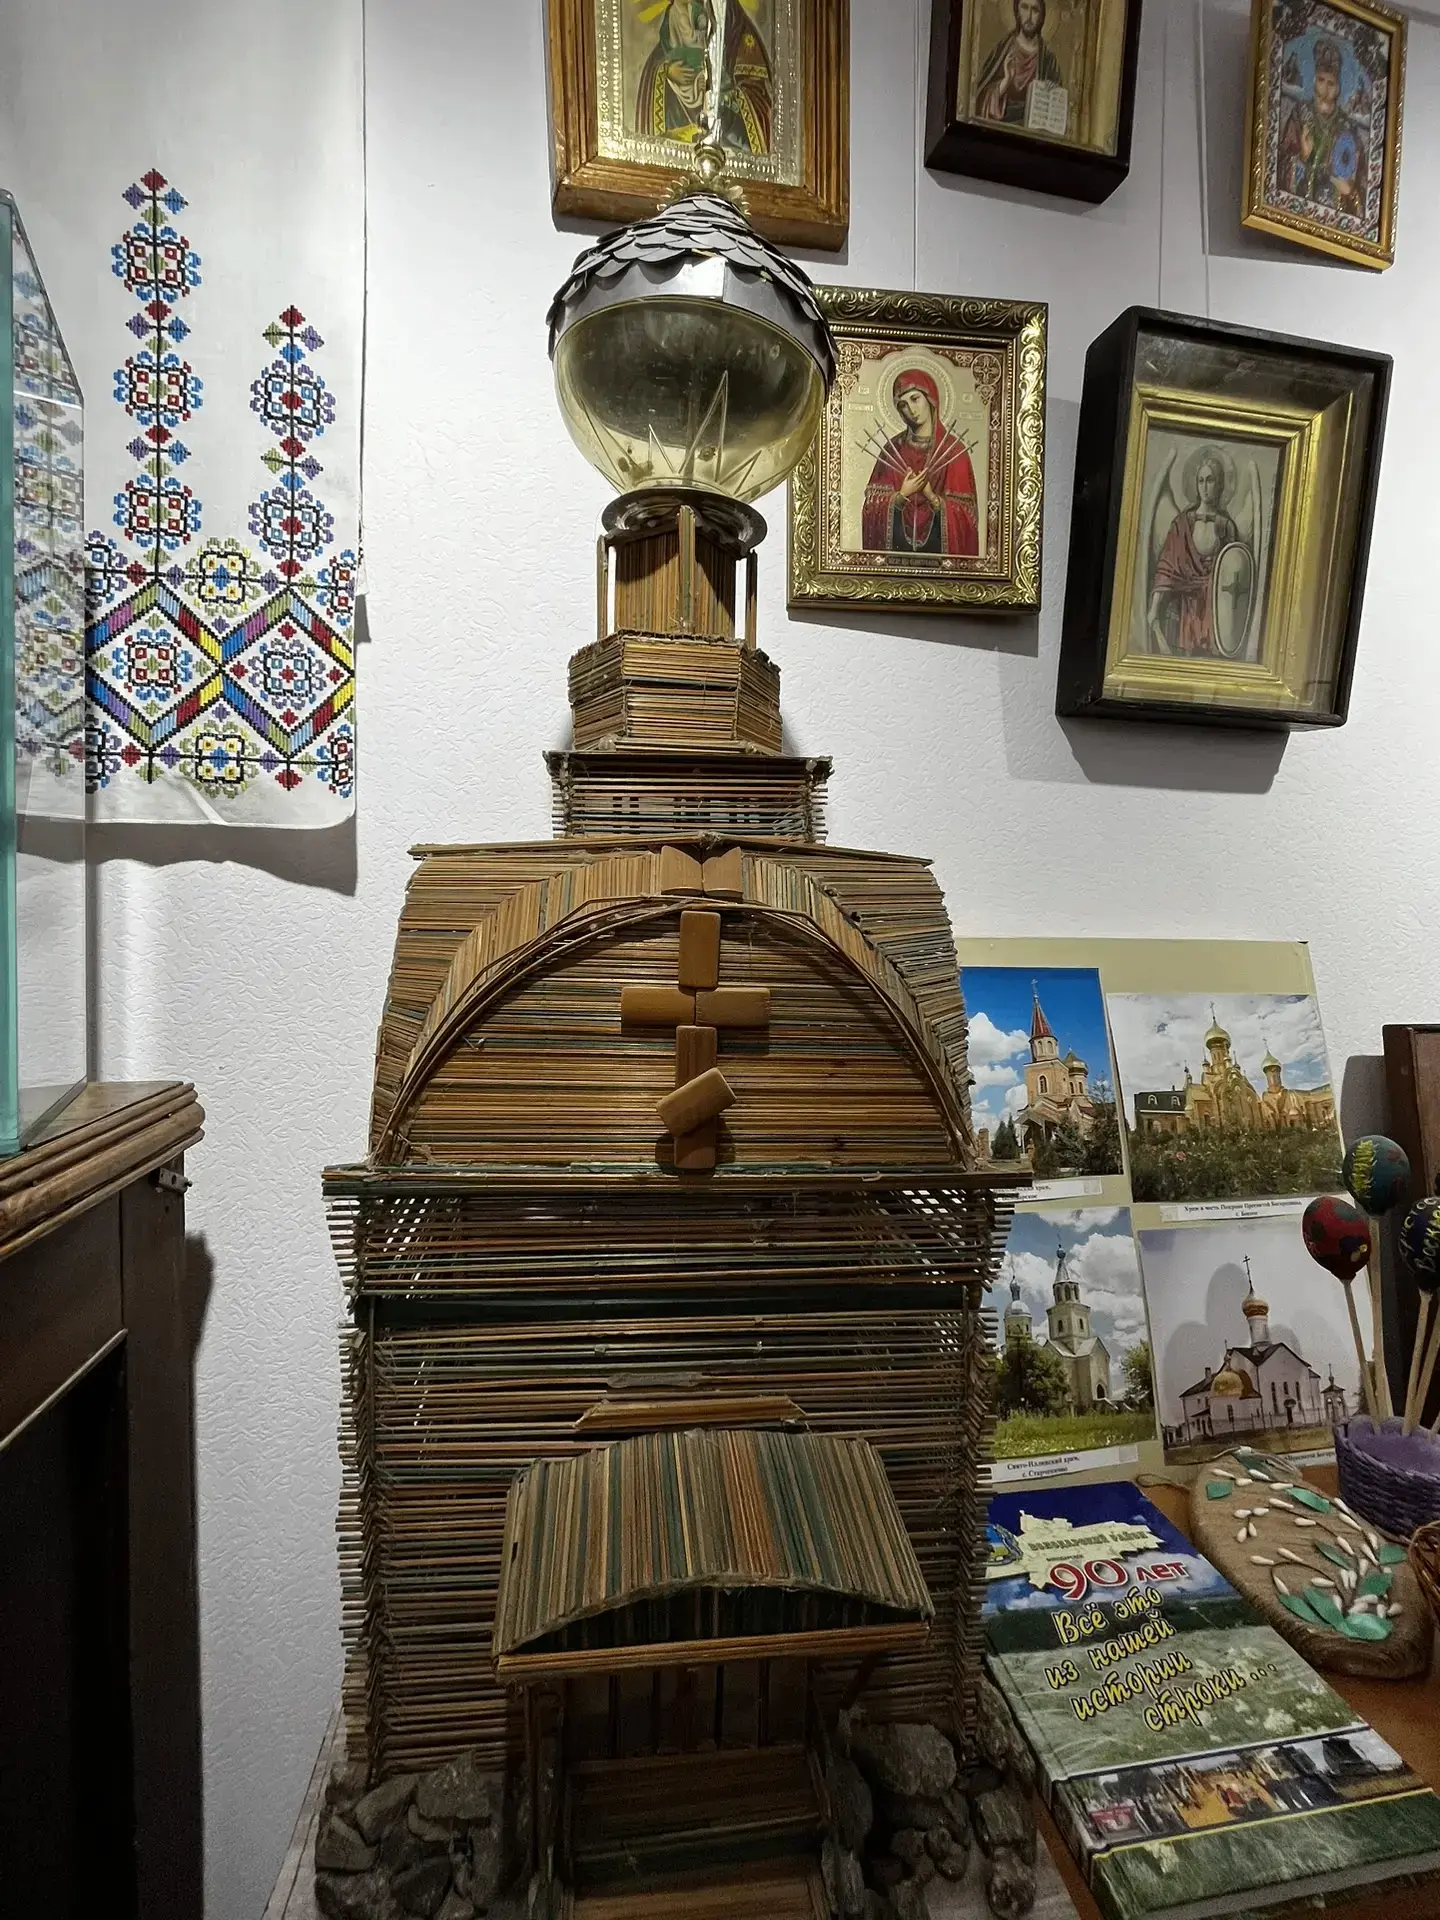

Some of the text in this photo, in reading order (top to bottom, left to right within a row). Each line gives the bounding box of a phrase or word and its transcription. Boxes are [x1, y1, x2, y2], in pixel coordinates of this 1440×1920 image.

[1050, 1559, 1128, 1600] 90
[1052, 1586, 1163, 1645] Всё это
[1045, 1611, 1175, 1689] из нашей
[1071, 1651, 1193, 1721] истории
